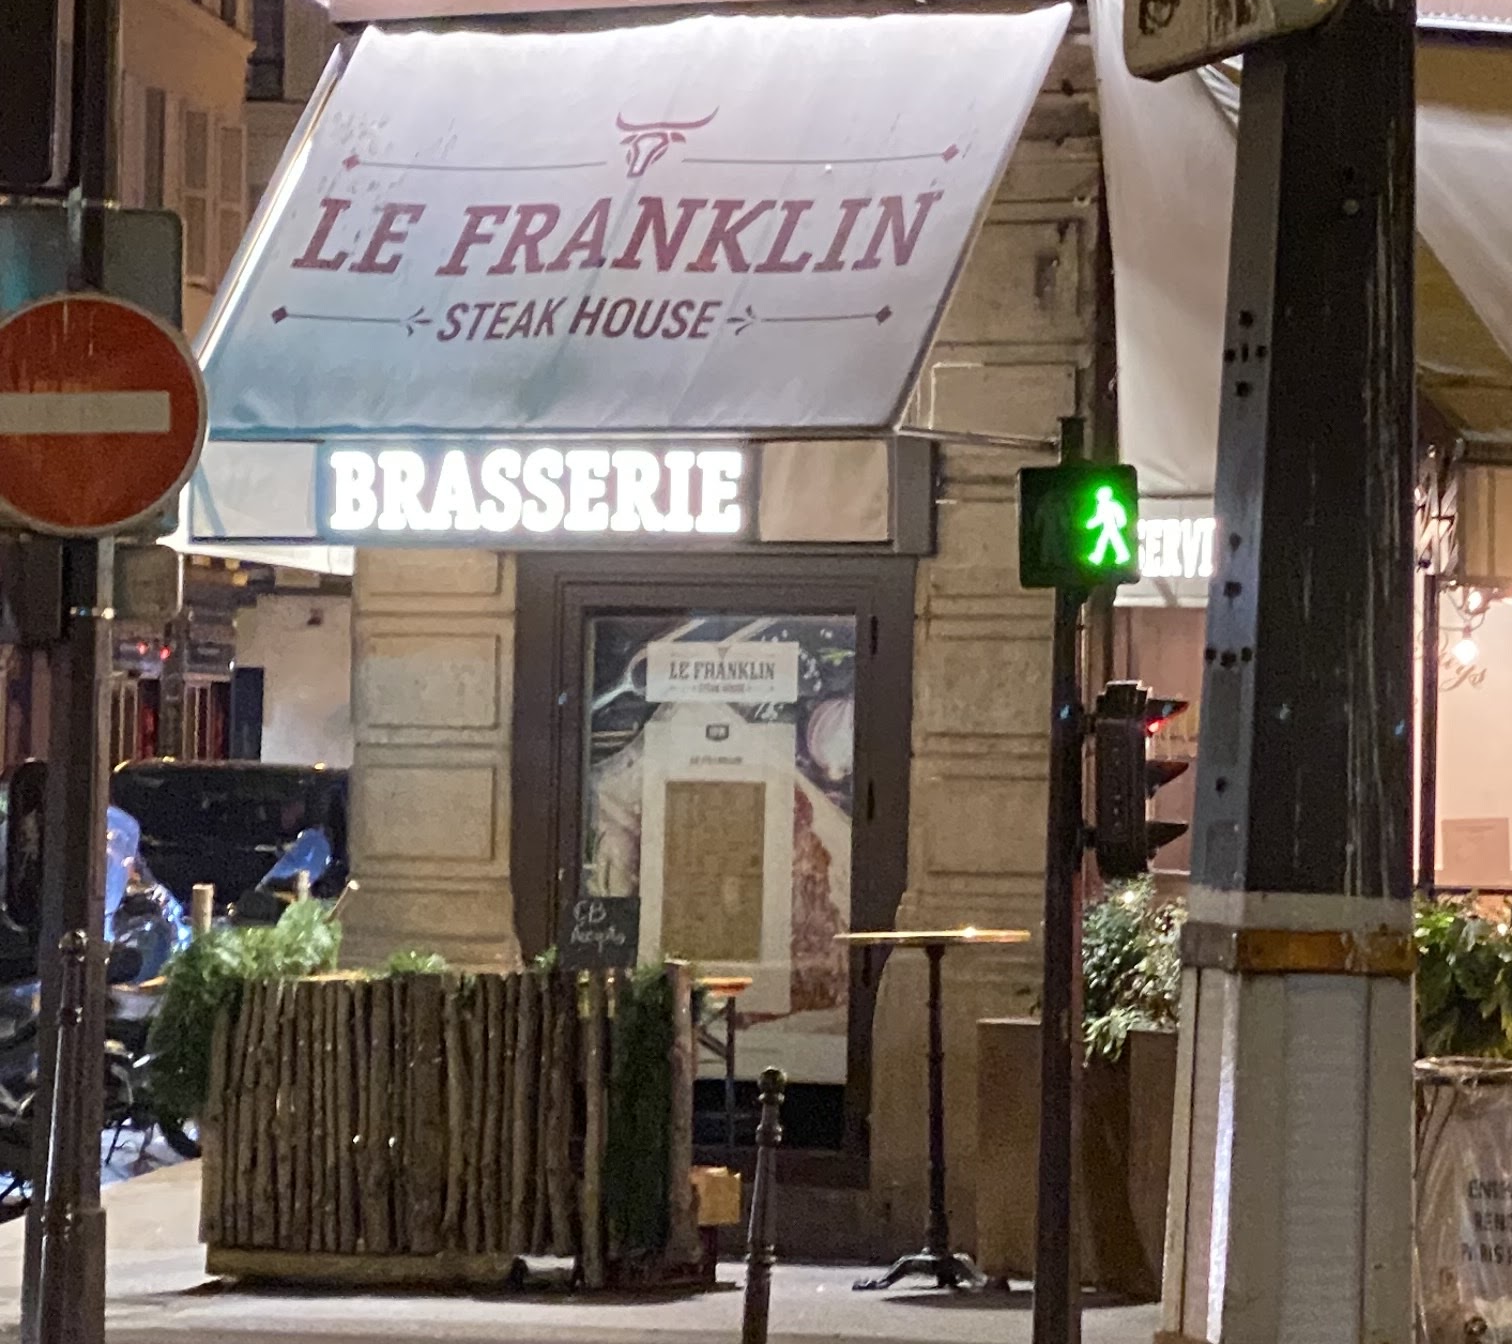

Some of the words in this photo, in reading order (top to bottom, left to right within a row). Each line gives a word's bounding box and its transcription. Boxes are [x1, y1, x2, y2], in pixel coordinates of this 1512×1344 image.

[292, 197, 426, 276] LE
[436, 189, 944, 277] FRANKLIN
[437, 298, 568, 343] STEAK
[569, 295, 723, 340] HOUSE
[328, 449, 745, 534] BRASSERIE
[668, 661, 690, 681] LE
[693, 661, 776, 681] FRANKLIN
